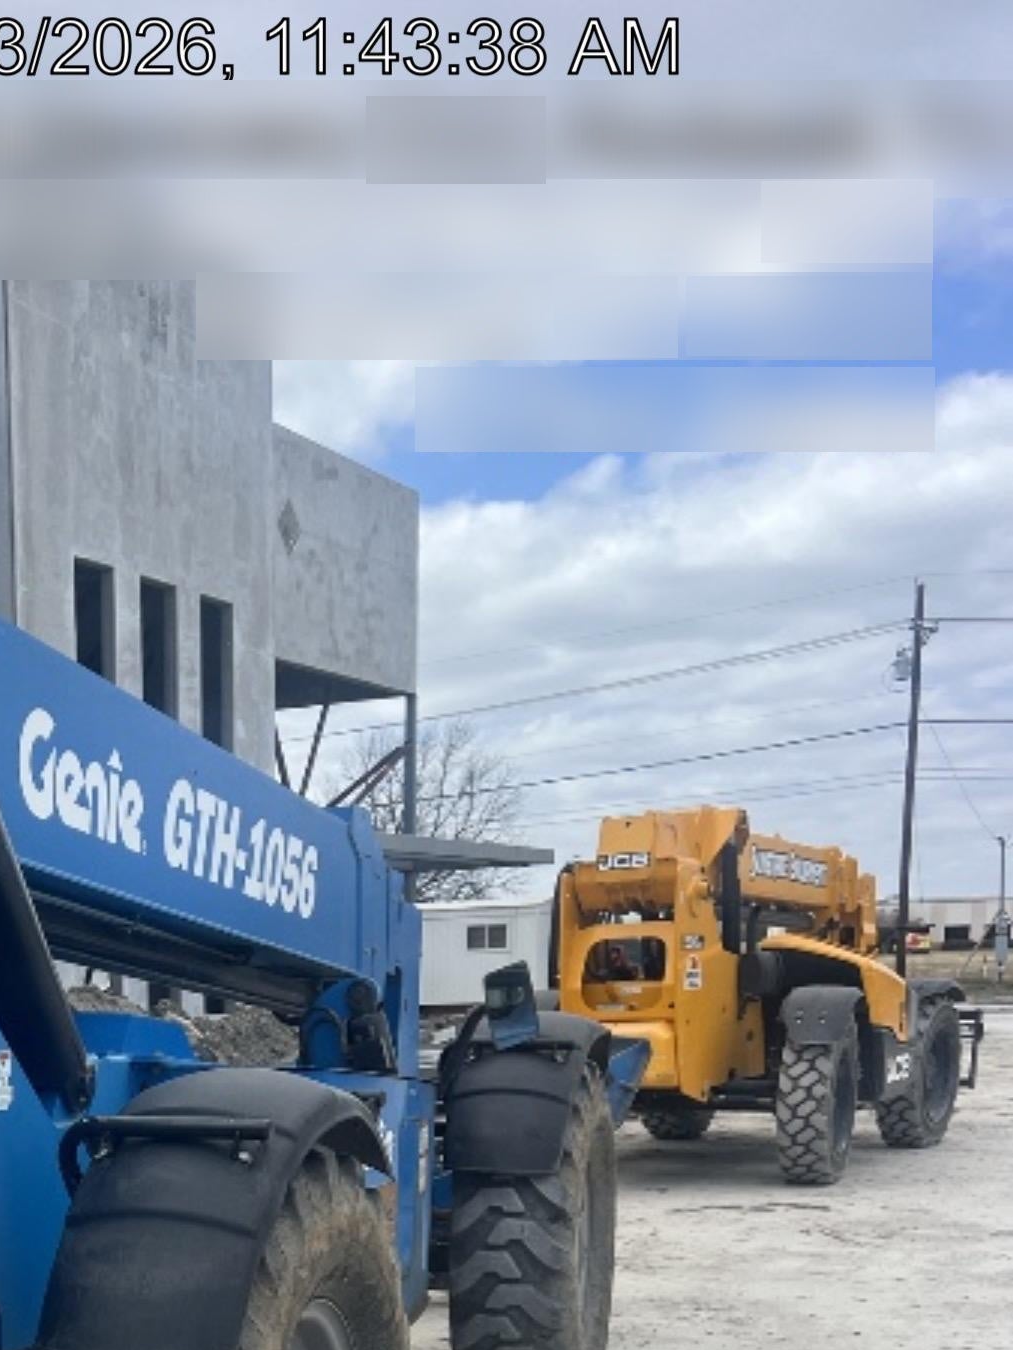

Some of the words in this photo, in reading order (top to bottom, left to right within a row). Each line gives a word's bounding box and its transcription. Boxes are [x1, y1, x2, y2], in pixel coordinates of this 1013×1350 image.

[19, 707, 145, 854] Genie
[163, 778, 318, 919] GTH-1056
[598, 853, 649, 871] JCB
